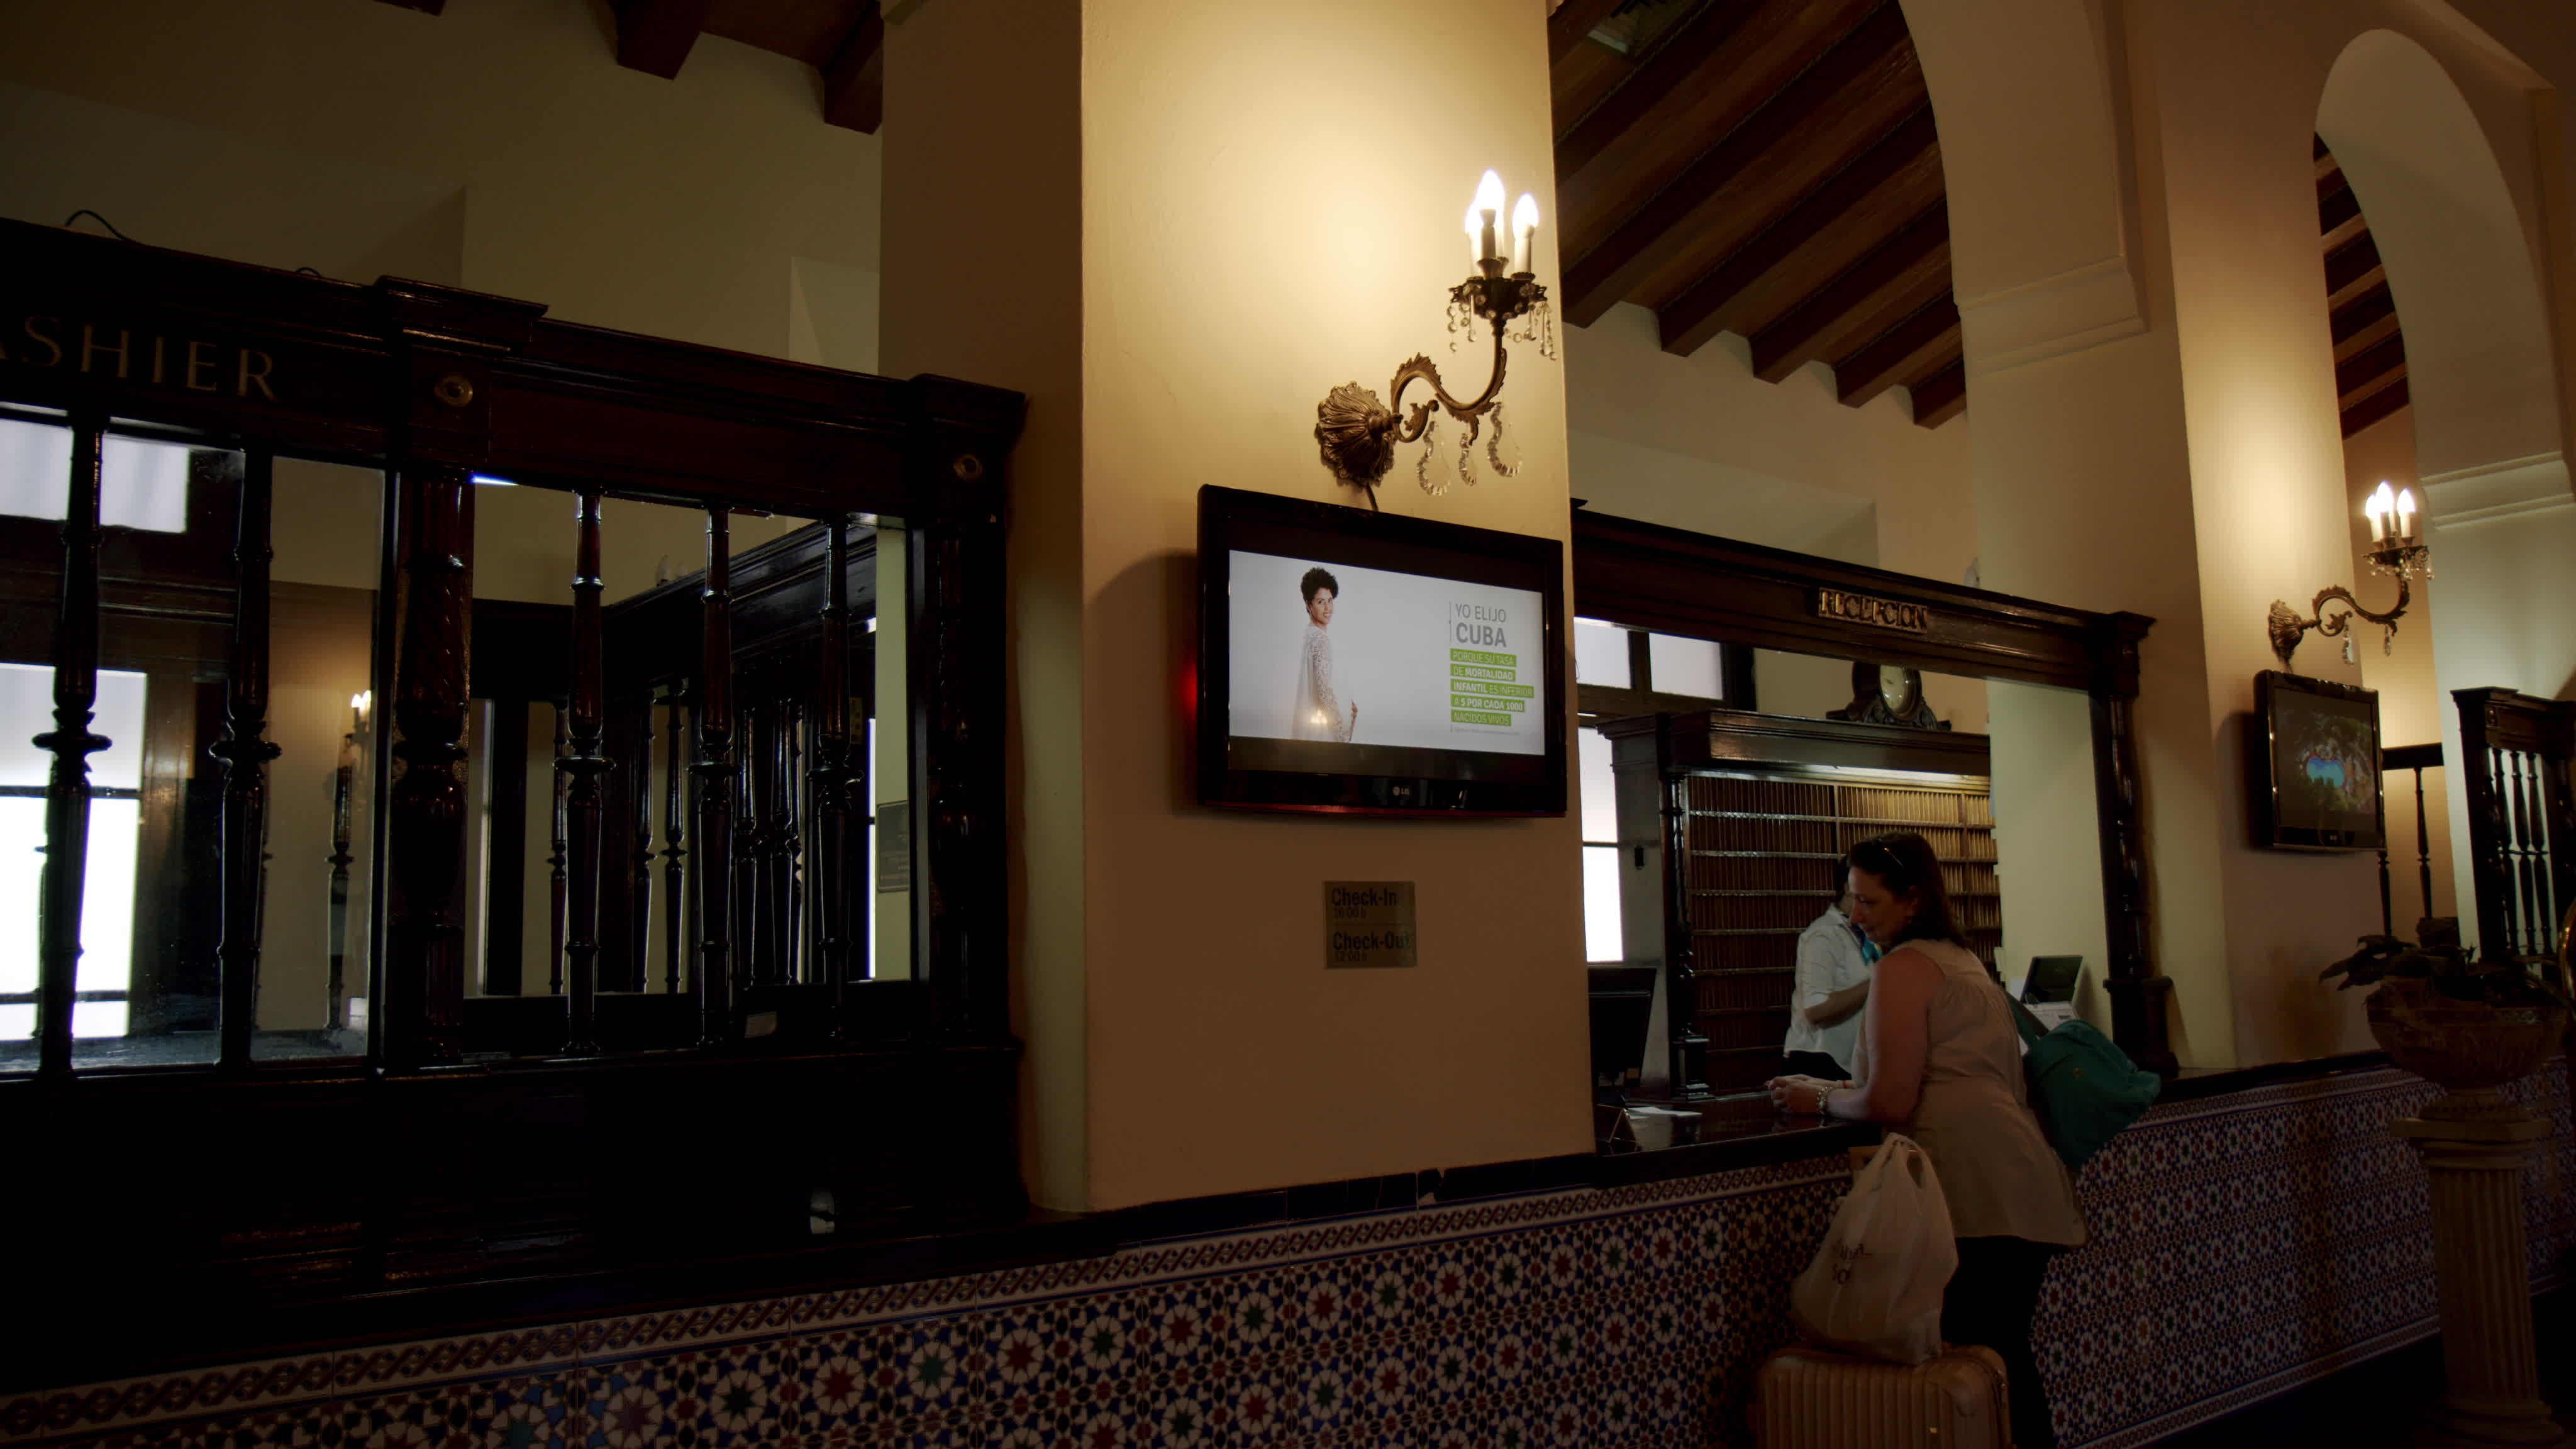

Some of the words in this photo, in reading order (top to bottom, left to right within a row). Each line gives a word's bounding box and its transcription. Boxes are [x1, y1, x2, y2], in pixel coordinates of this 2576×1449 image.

[0, 313, 278, 403] SHIER
[1455, 602, 1471, 619] YO
[1474, 605, 1506, 623] ELIJO
[1456, 623, 1507, 648] CUBA
[1453, 651, 1484, 663] PORQUE
[1485, 653, 1494, 664] SU
[1496, 655, 1514, 665] TASA
[1453, 667, 1464, 675] DE
[1465, 668, 1513, 680] MORTALIDAD
[1453, 682, 1488, 693] INFANTIL
[1489, 684, 1498, 694] ES
[1500, 686, 1533, 697] INFERIOR
[1467, 699, 1483, 708] POR
[1484, 699, 1504, 709] CADA
[1506, 702, 1523, 711] 1000
[1453, 713, 1487, 723] NACIDOS
[1489, 715, 1510, 725] VIVOS
[1331, 887, 1399, 906] Check-In
